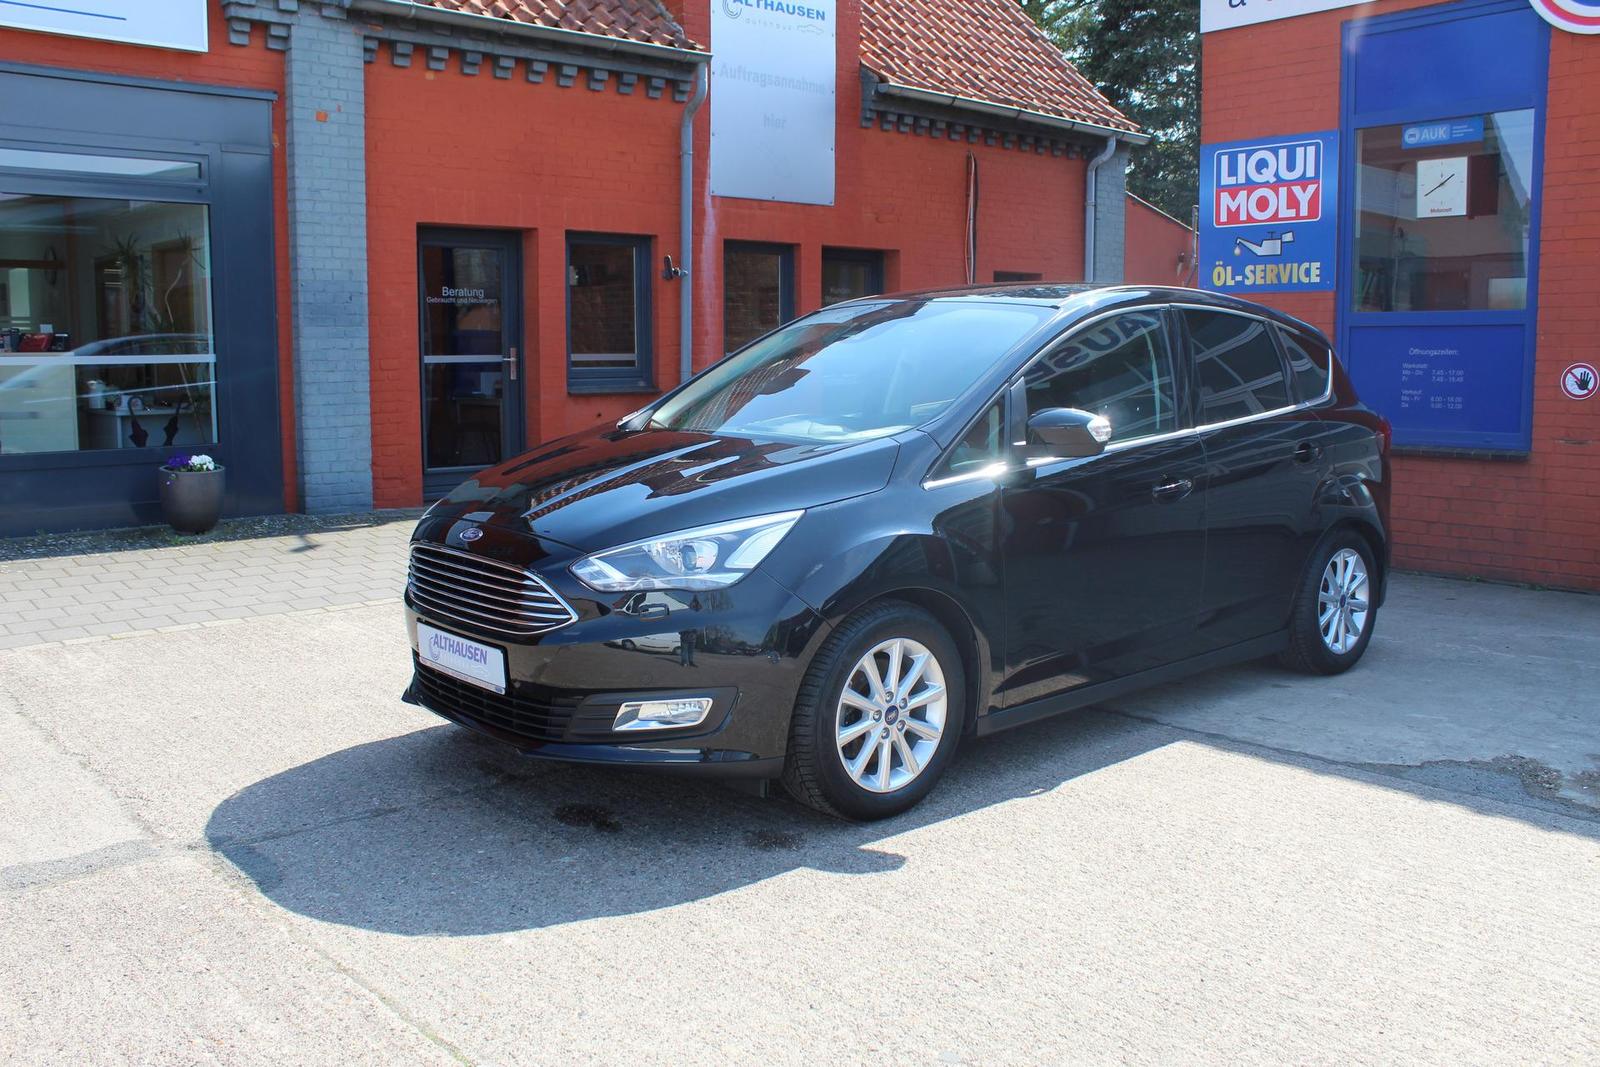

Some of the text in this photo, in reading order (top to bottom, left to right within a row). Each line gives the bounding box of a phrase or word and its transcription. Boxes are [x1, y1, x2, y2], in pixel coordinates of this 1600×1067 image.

[763, 113, 787, 129] hier
[1421, 126, 1447, 141] AUK
[1220, 146, 1316, 186] LIQUI
[1220, 184, 1318, 223] MOLY
[1213, 261, 1321, 286] ÖL-SERVICE
[442, 287, 485, 299] Beratung
[433, 633, 488, 665] ALTHAUSEN
